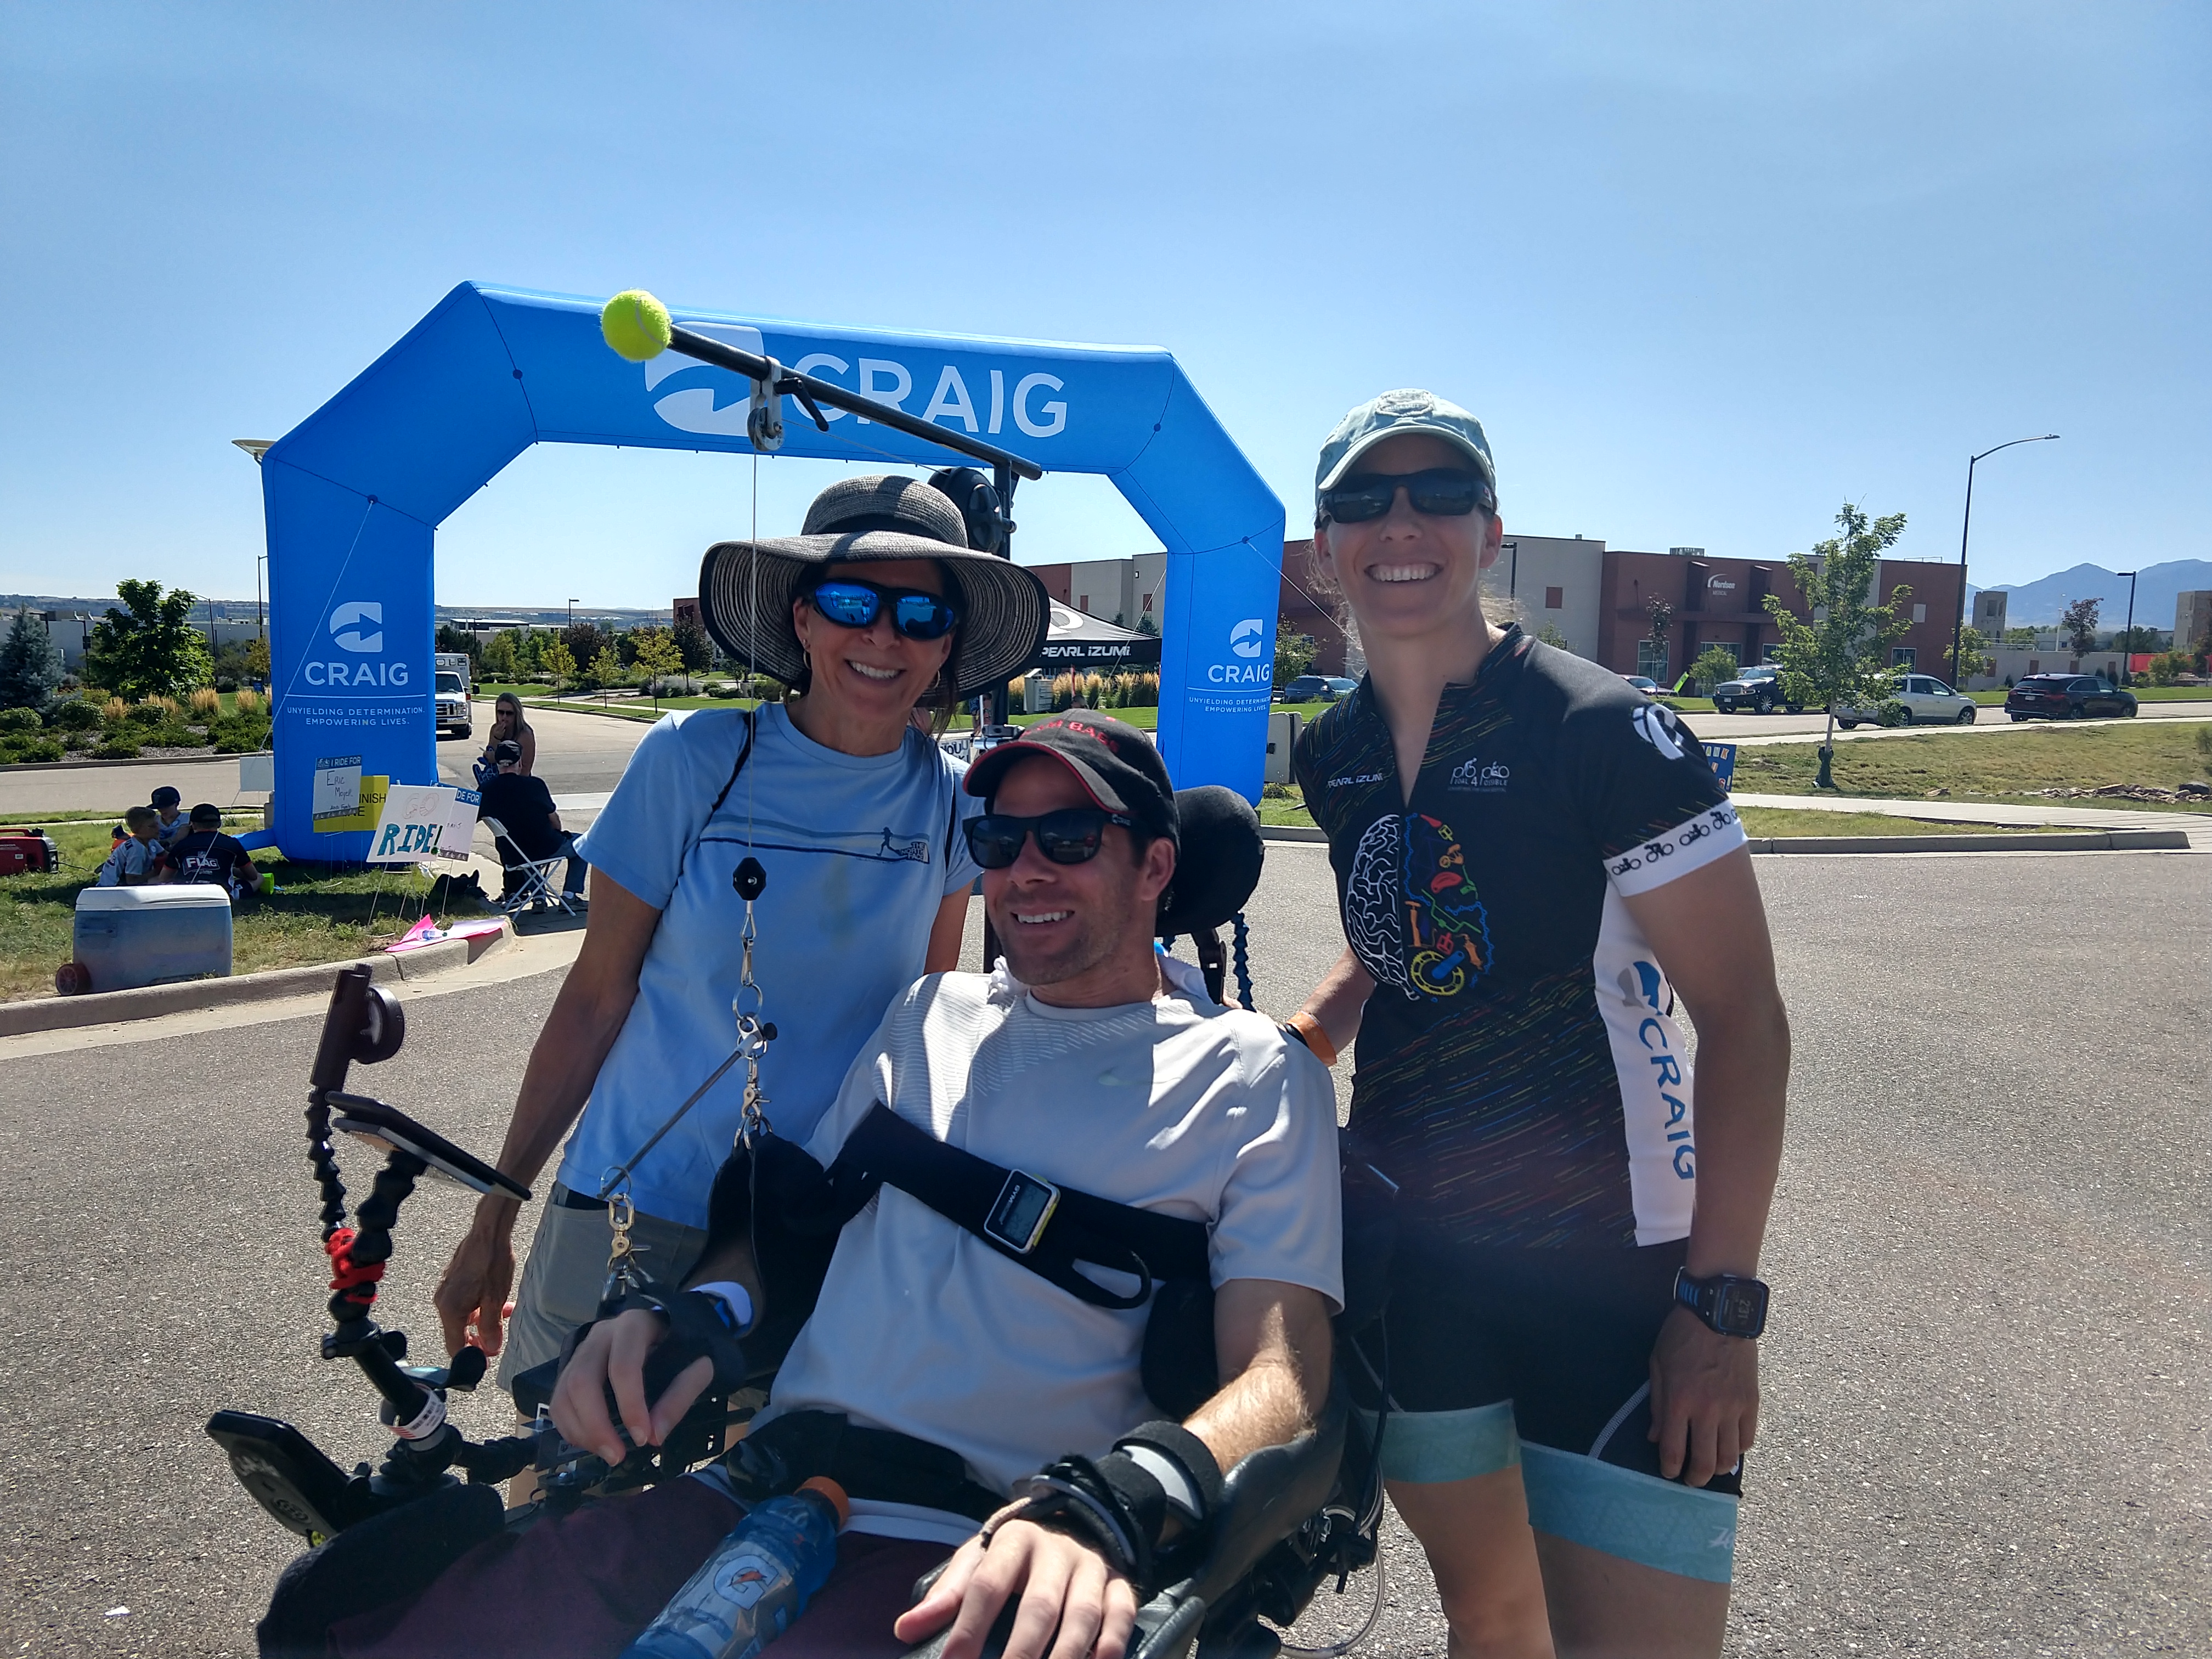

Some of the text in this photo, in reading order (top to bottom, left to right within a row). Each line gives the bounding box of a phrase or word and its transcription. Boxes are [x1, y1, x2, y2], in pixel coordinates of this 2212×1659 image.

[791, 353, 1068, 438] CRAIG
[1039, 646, 1085, 657] PEARL
[304, 662, 408, 686] CRAIG
[1207, 663, 1270, 683] CRAIG
[1189, 696, 1233, 705] UNYIELDING
[287, 707, 425, 715] UNYIELDING DETERMINATION.
[334, 758, 348, 766] RIDE
[349, 756, 361, 764] FOR
[1328, 777, 1354, 788] PEARL
[1471, 776, 1478, 786] 4
[359, 793, 386, 804] INISH
[456, 790, 480, 803] DE FOR
[377, 823, 443, 856] RIDE!
[186, 857, 218, 868] FLAG
[1639, 1018, 1695, 1180] CRAIG
[714, 1554, 780, 1610] G
